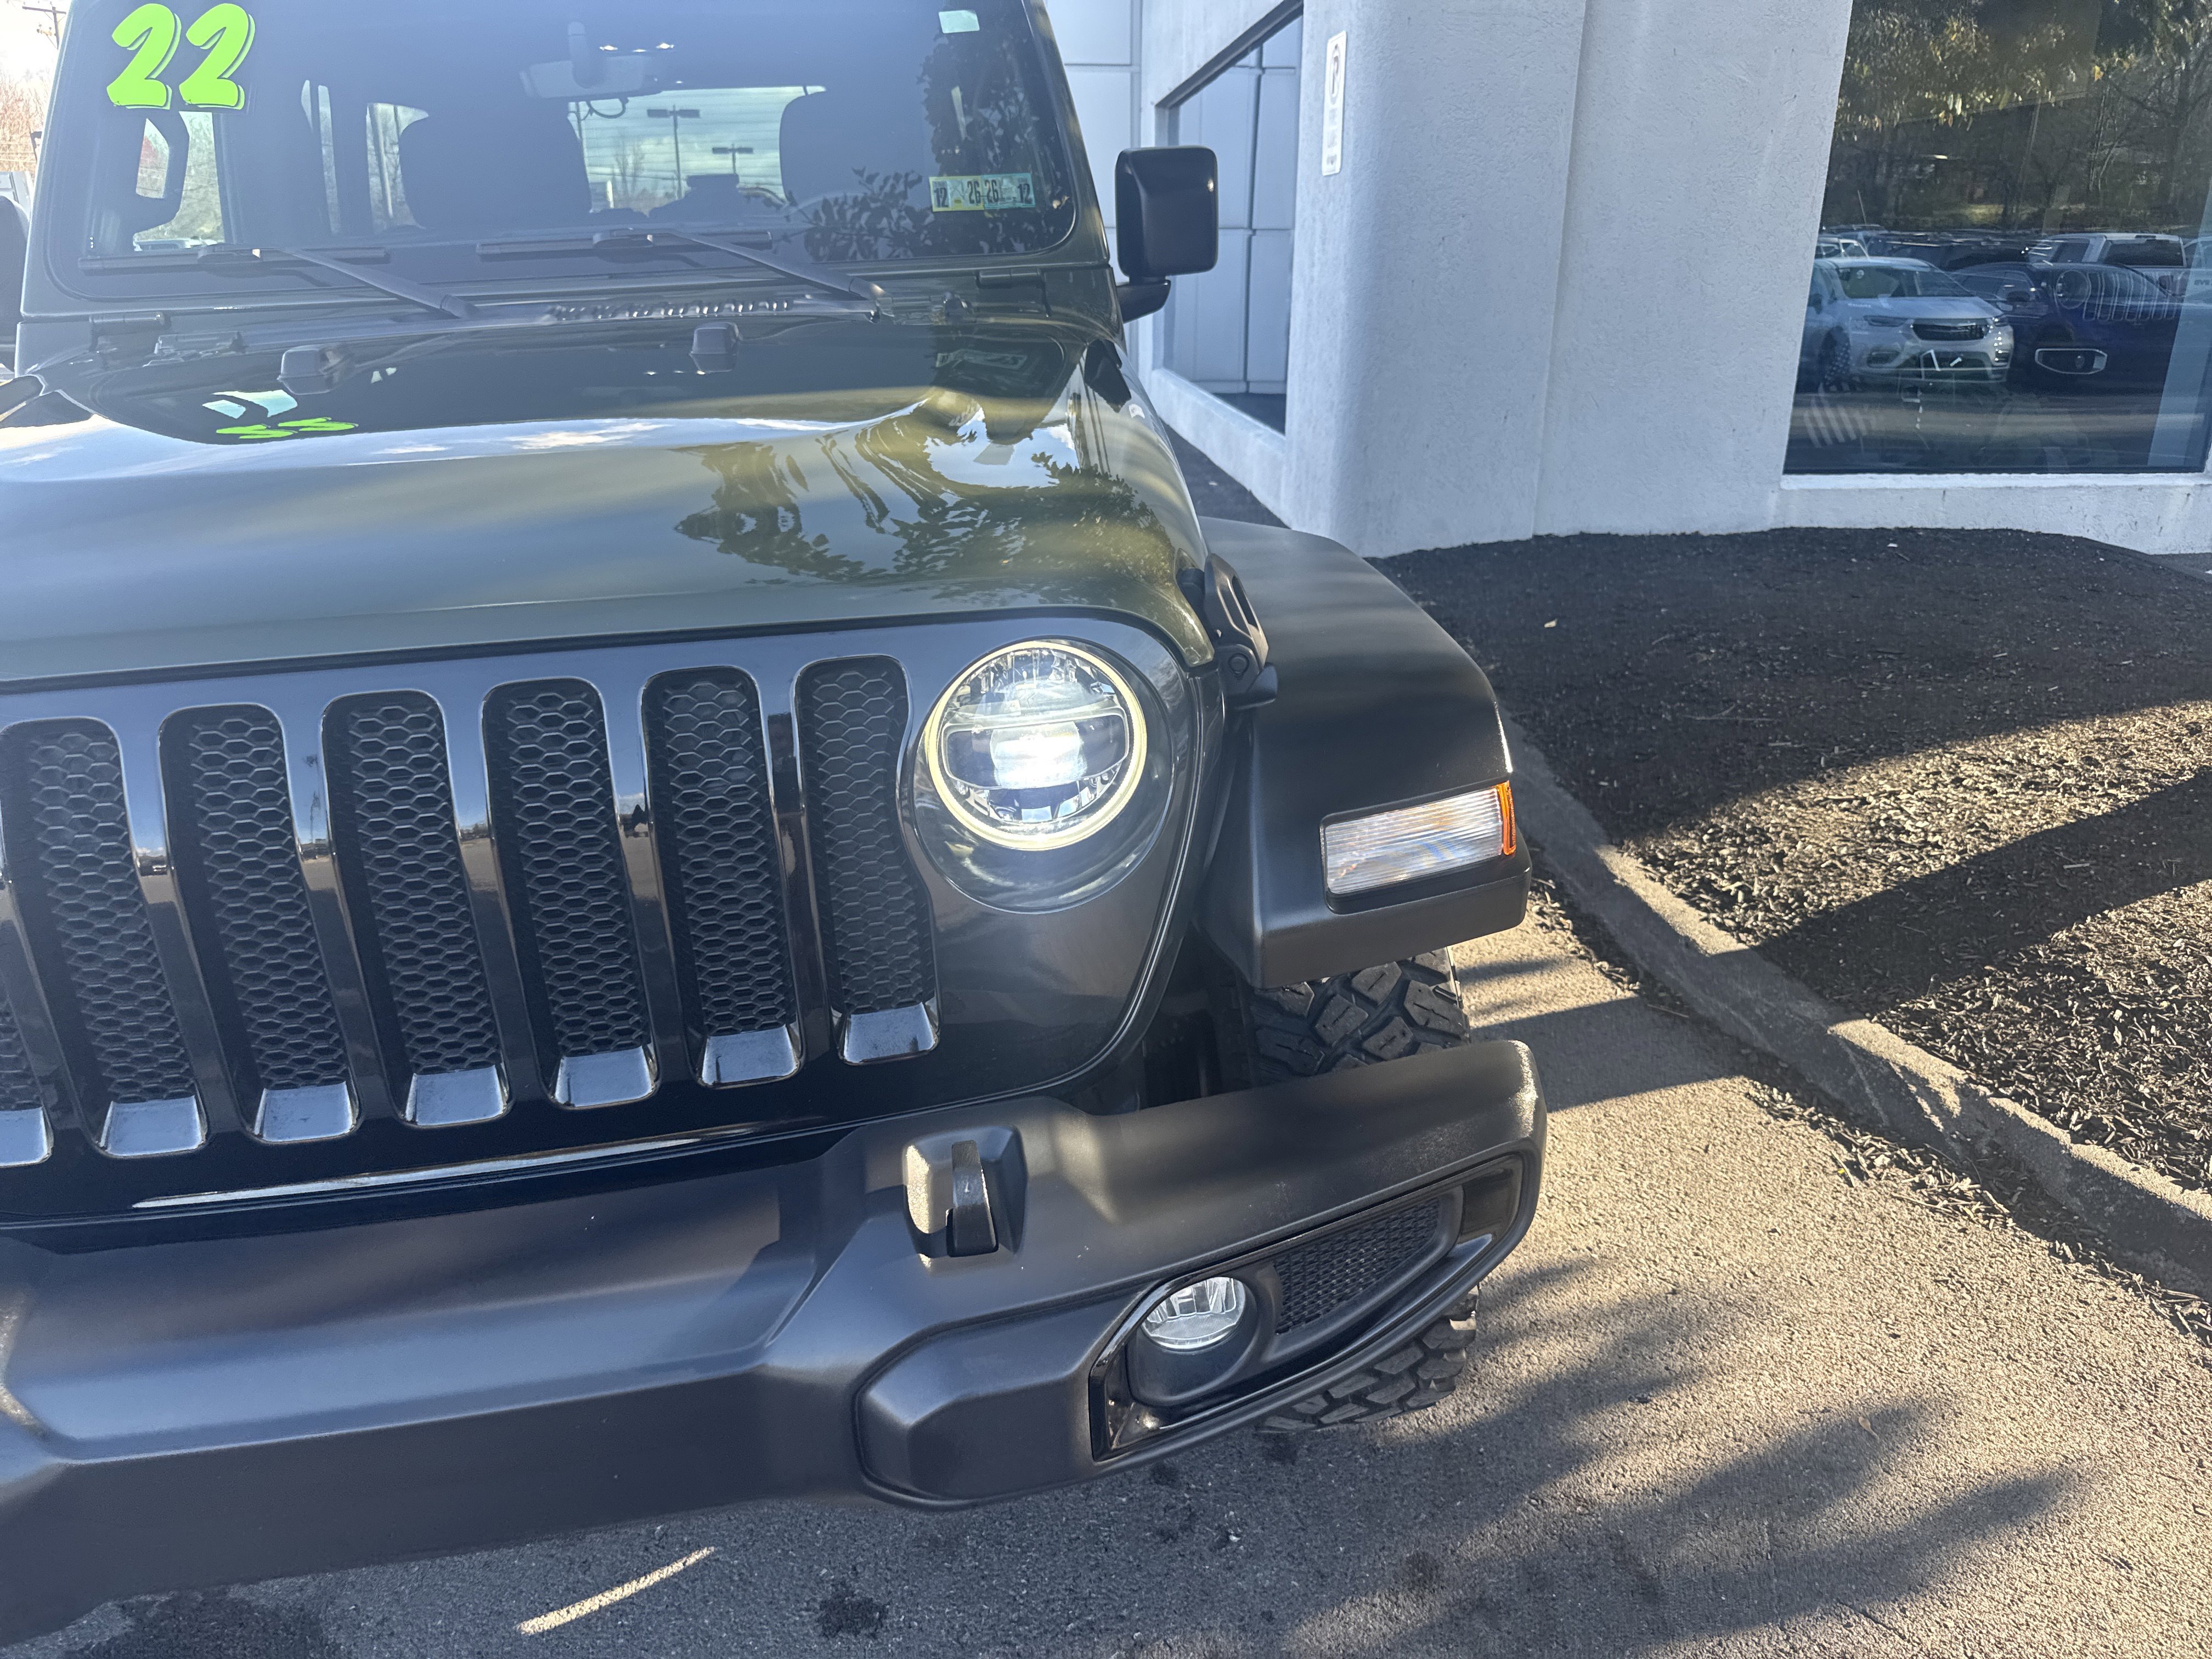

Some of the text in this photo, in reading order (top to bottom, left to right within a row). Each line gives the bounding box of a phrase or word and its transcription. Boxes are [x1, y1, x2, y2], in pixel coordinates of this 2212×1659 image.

[106, 3, 256, 110] 22
[934, 180, 981, 208] 12 26
[984, 179, 1032, 204] 26 12
